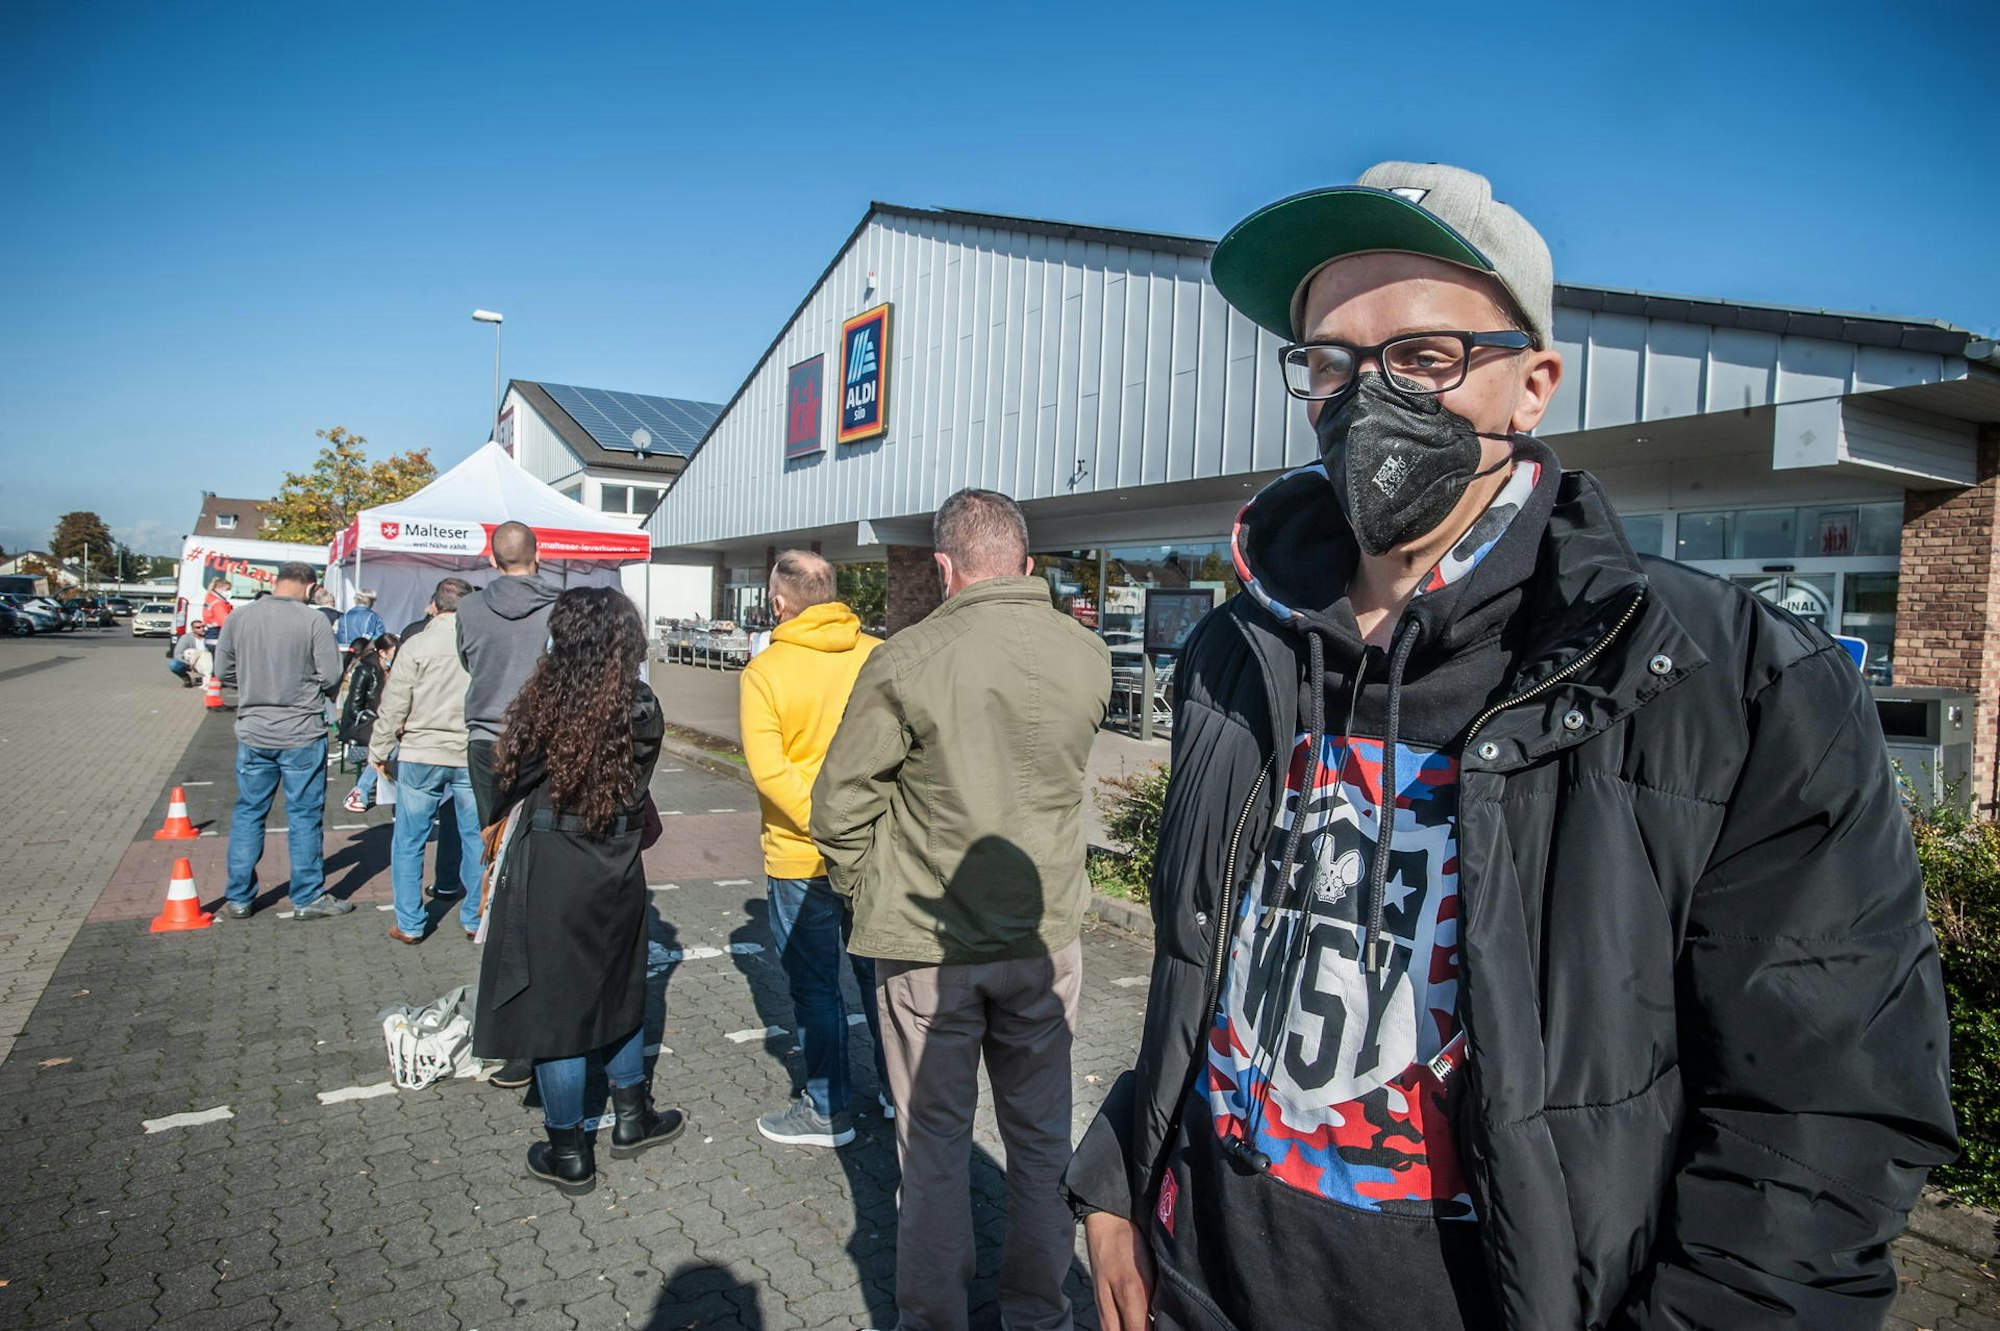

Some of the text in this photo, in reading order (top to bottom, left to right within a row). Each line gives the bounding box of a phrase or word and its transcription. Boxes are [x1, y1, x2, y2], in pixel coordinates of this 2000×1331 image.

[846, 380, 876, 409] ALDI
[854, 406, 866, 421] SÜD
[405, 524, 469, 539] Malteser
